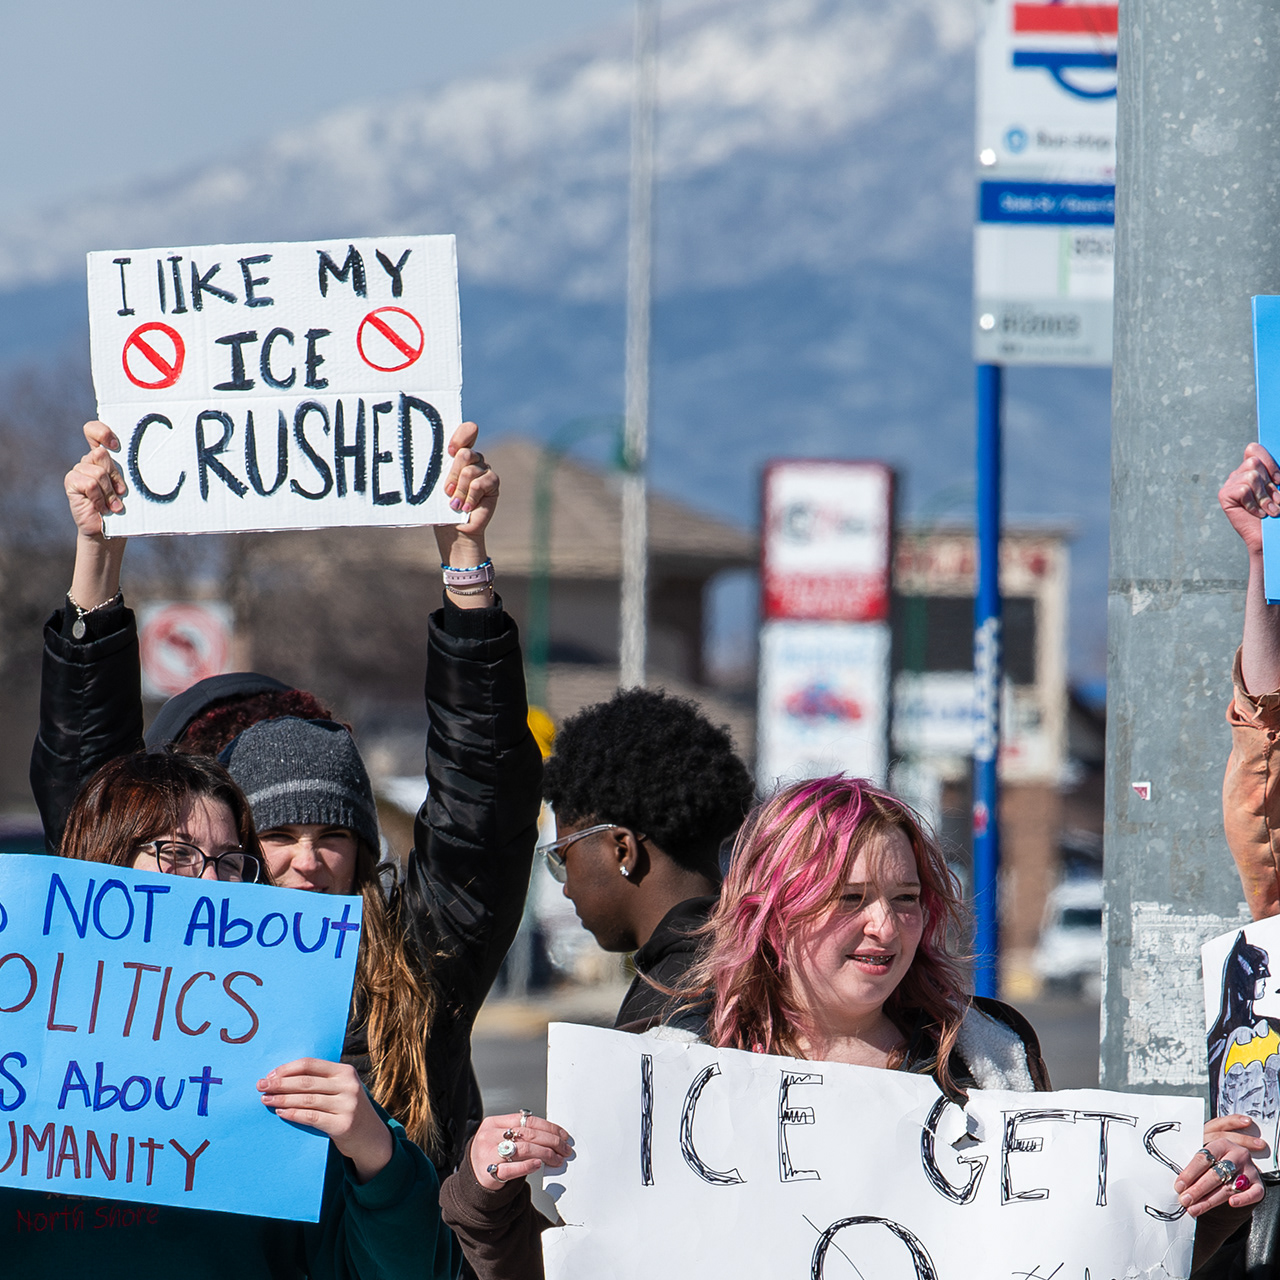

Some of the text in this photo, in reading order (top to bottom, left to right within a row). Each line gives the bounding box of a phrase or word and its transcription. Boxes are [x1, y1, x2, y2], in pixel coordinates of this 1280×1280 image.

[112, 257, 135, 316] I
[317, 243, 413, 299] MY
[212, 326, 333, 391] ICE
[127, 390, 445, 506] CRUSHED
[42, 872, 171, 943] NOT
[640, 1053, 1187, 1222] ICE GETS
[17, 1200, 159, 1233] North Shore
